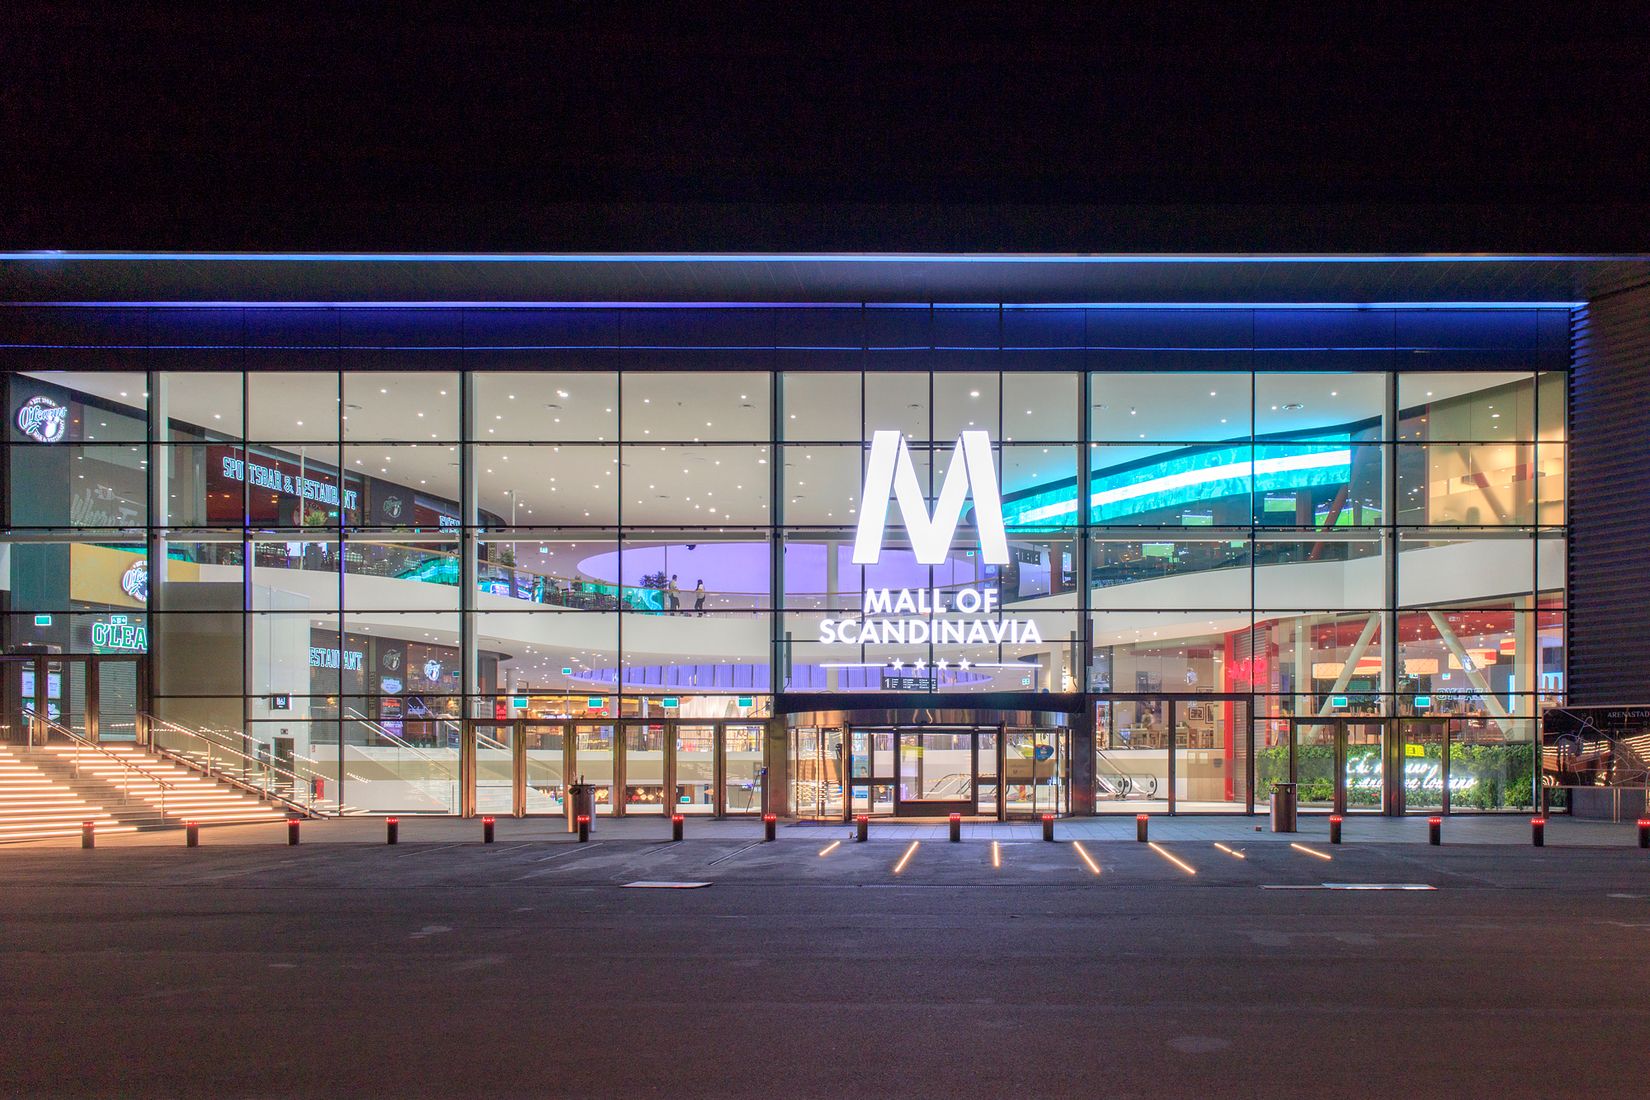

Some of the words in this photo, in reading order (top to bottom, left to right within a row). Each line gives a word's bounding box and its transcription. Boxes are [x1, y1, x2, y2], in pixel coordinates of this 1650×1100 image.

[222, 456, 282, 491] SPOTSBAR
[284, 476, 295, 494] &
[296, 476, 357, 511] RESTAURNT
[852, 430, 1010, 564] M
[863, 587, 948, 614] MALL
[956, 587, 999, 615] OF
[819, 618, 1042, 645] SCANDINAVIA
[309, 647, 363, 671] ESTAUANT
